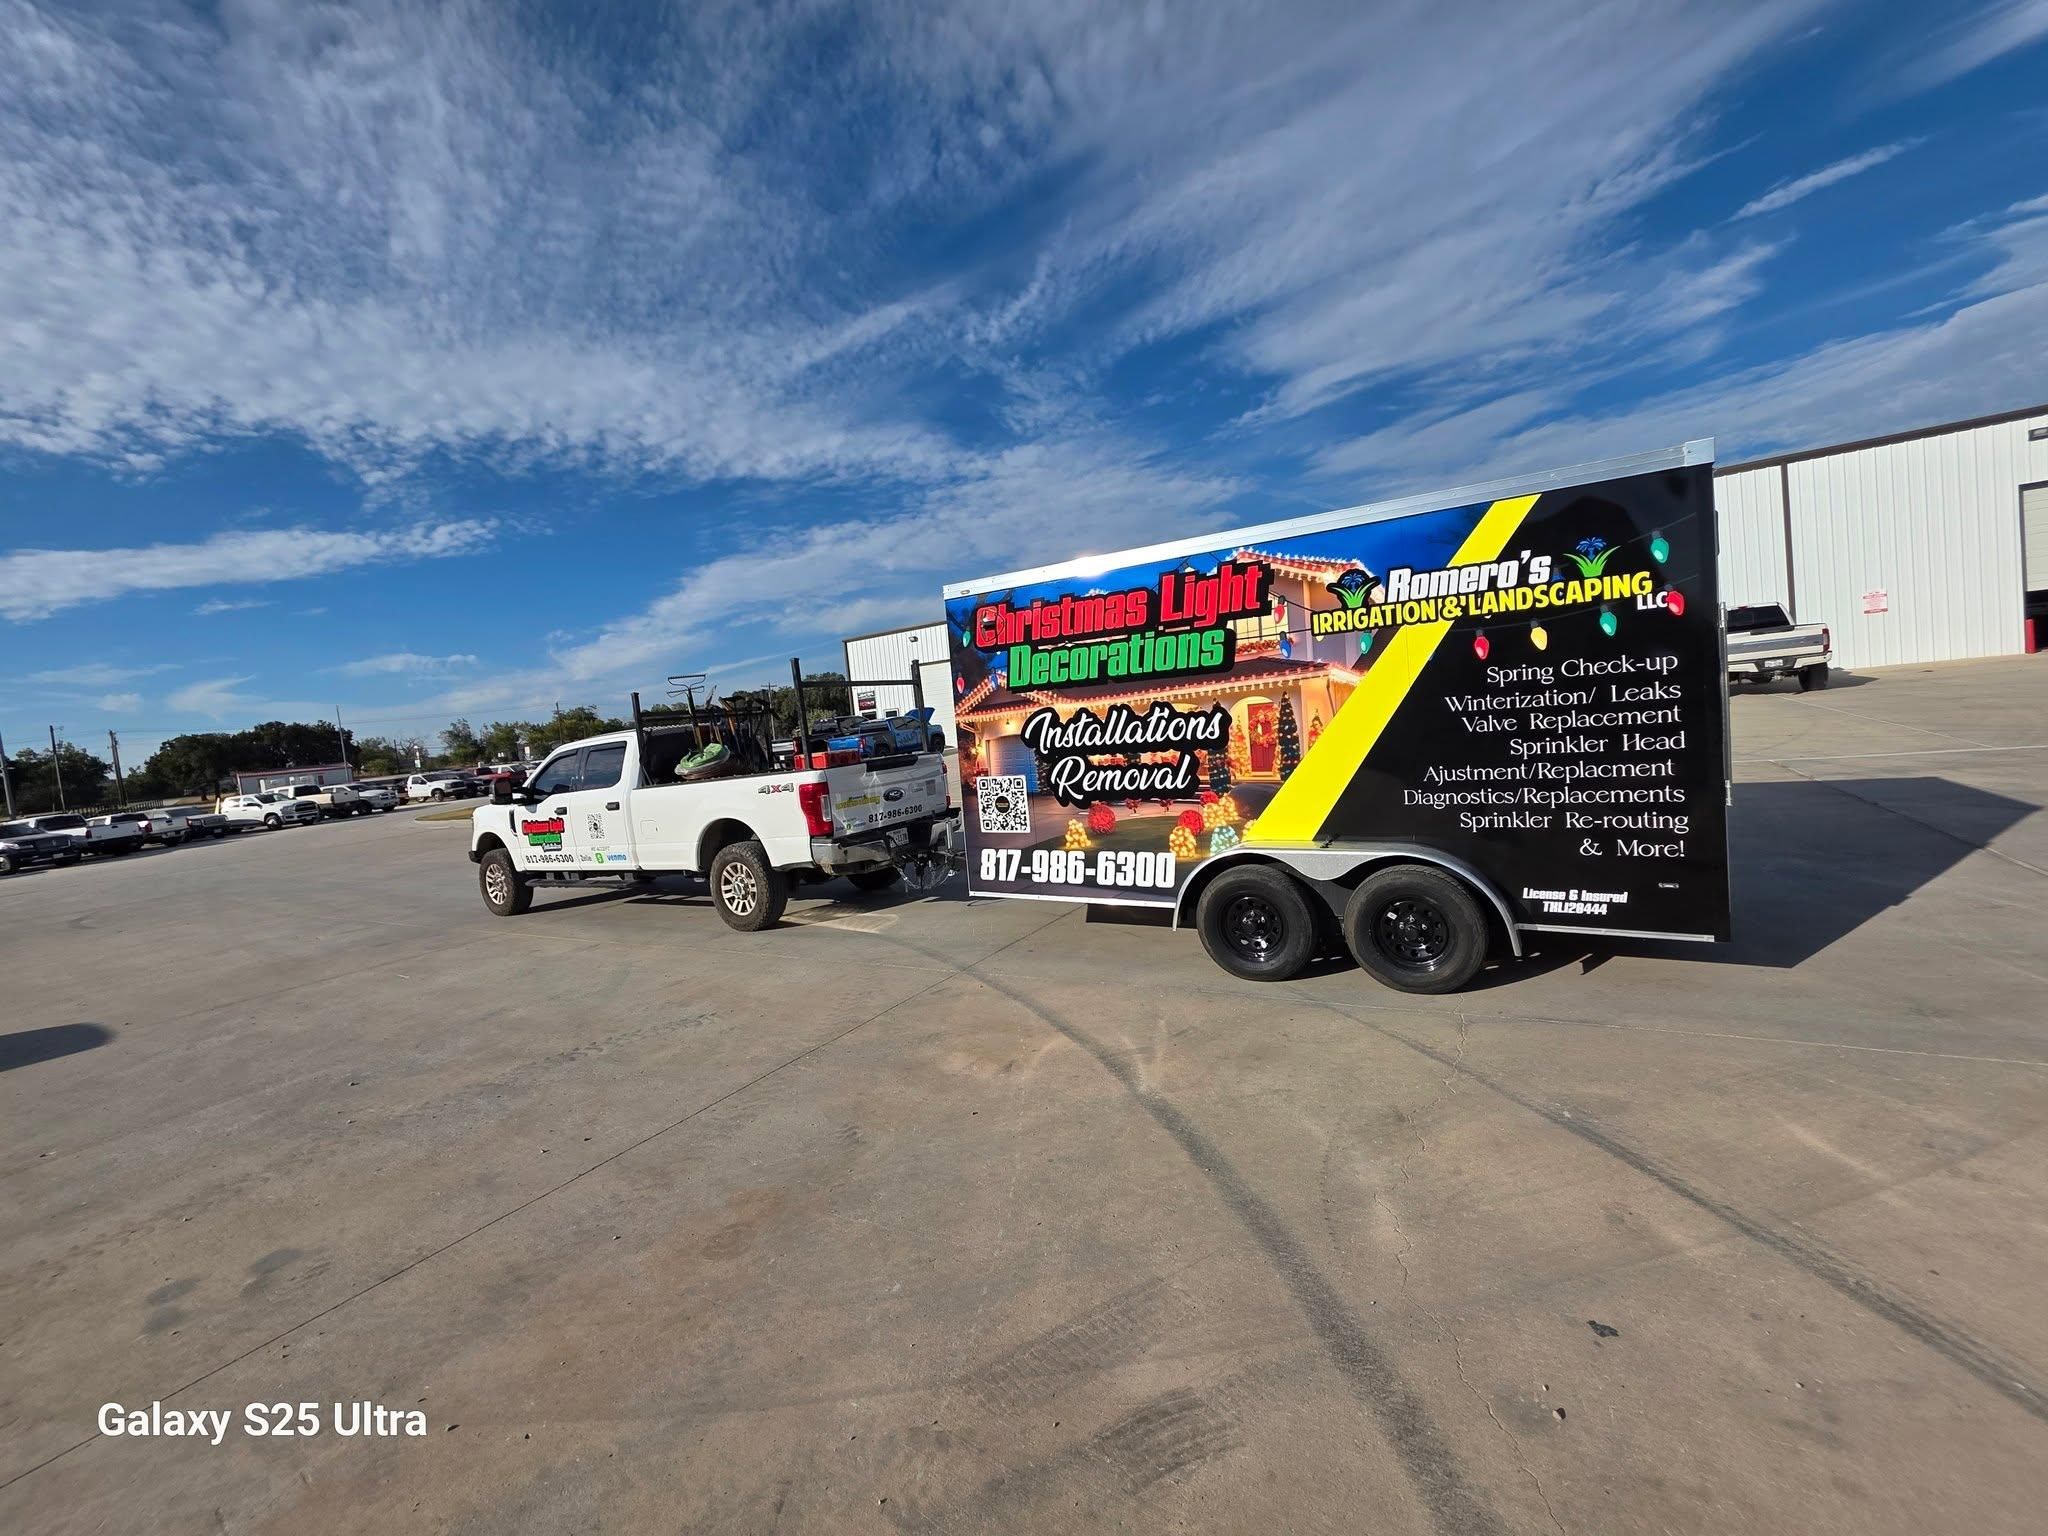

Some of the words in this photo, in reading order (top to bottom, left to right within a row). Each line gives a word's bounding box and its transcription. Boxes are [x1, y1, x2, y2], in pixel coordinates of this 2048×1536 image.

[1387, 550, 1552, 603] Romero's
[975, 590, 1148, 648] Christmas
[1160, 564, 1263, 627] Light
[1312, 600, 1436, 634] IRRIGATION
[1442, 596, 1466, 618] &
[1469, 571, 1653, 616] LANDSCAPING
[1637, 591, 1668, 611] LLC
[1009, 629, 1226, 687] Decorations
[1487, 664, 1554, 687] Spring
[1561, 655, 1678, 677] Check-up
[1445, 685, 1596, 713] Winterization/
[1611, 682, 1682, 702] Leaks
[1025, 706, 1224, 754] Installations
[1462, 715, 1518, 732] Valve
[1529, 705, 1682, 734] Replacement
[1510, 735, 1609, 759] Sprinkler
[1623, 731, 1686, 751] Head
[1051, 755, 1191, 800] Removal
[1424, 759, 1674, 785] Ajustment/Replacment
[1404, 785, 1686, 808] Diagnostics/Replacements
[1460, 811, 1553, 832] Sprinkler
[1566, 812, 1690, 834] Re-routing
[1580, 839, 1602, 856] &
[1617, 840, 1685, 858] More!
[980, 848, 1177, 888] 817-986-6300
[1523, 888, 1566, 901] License
[1582, 891, 1628, 904] Insured
